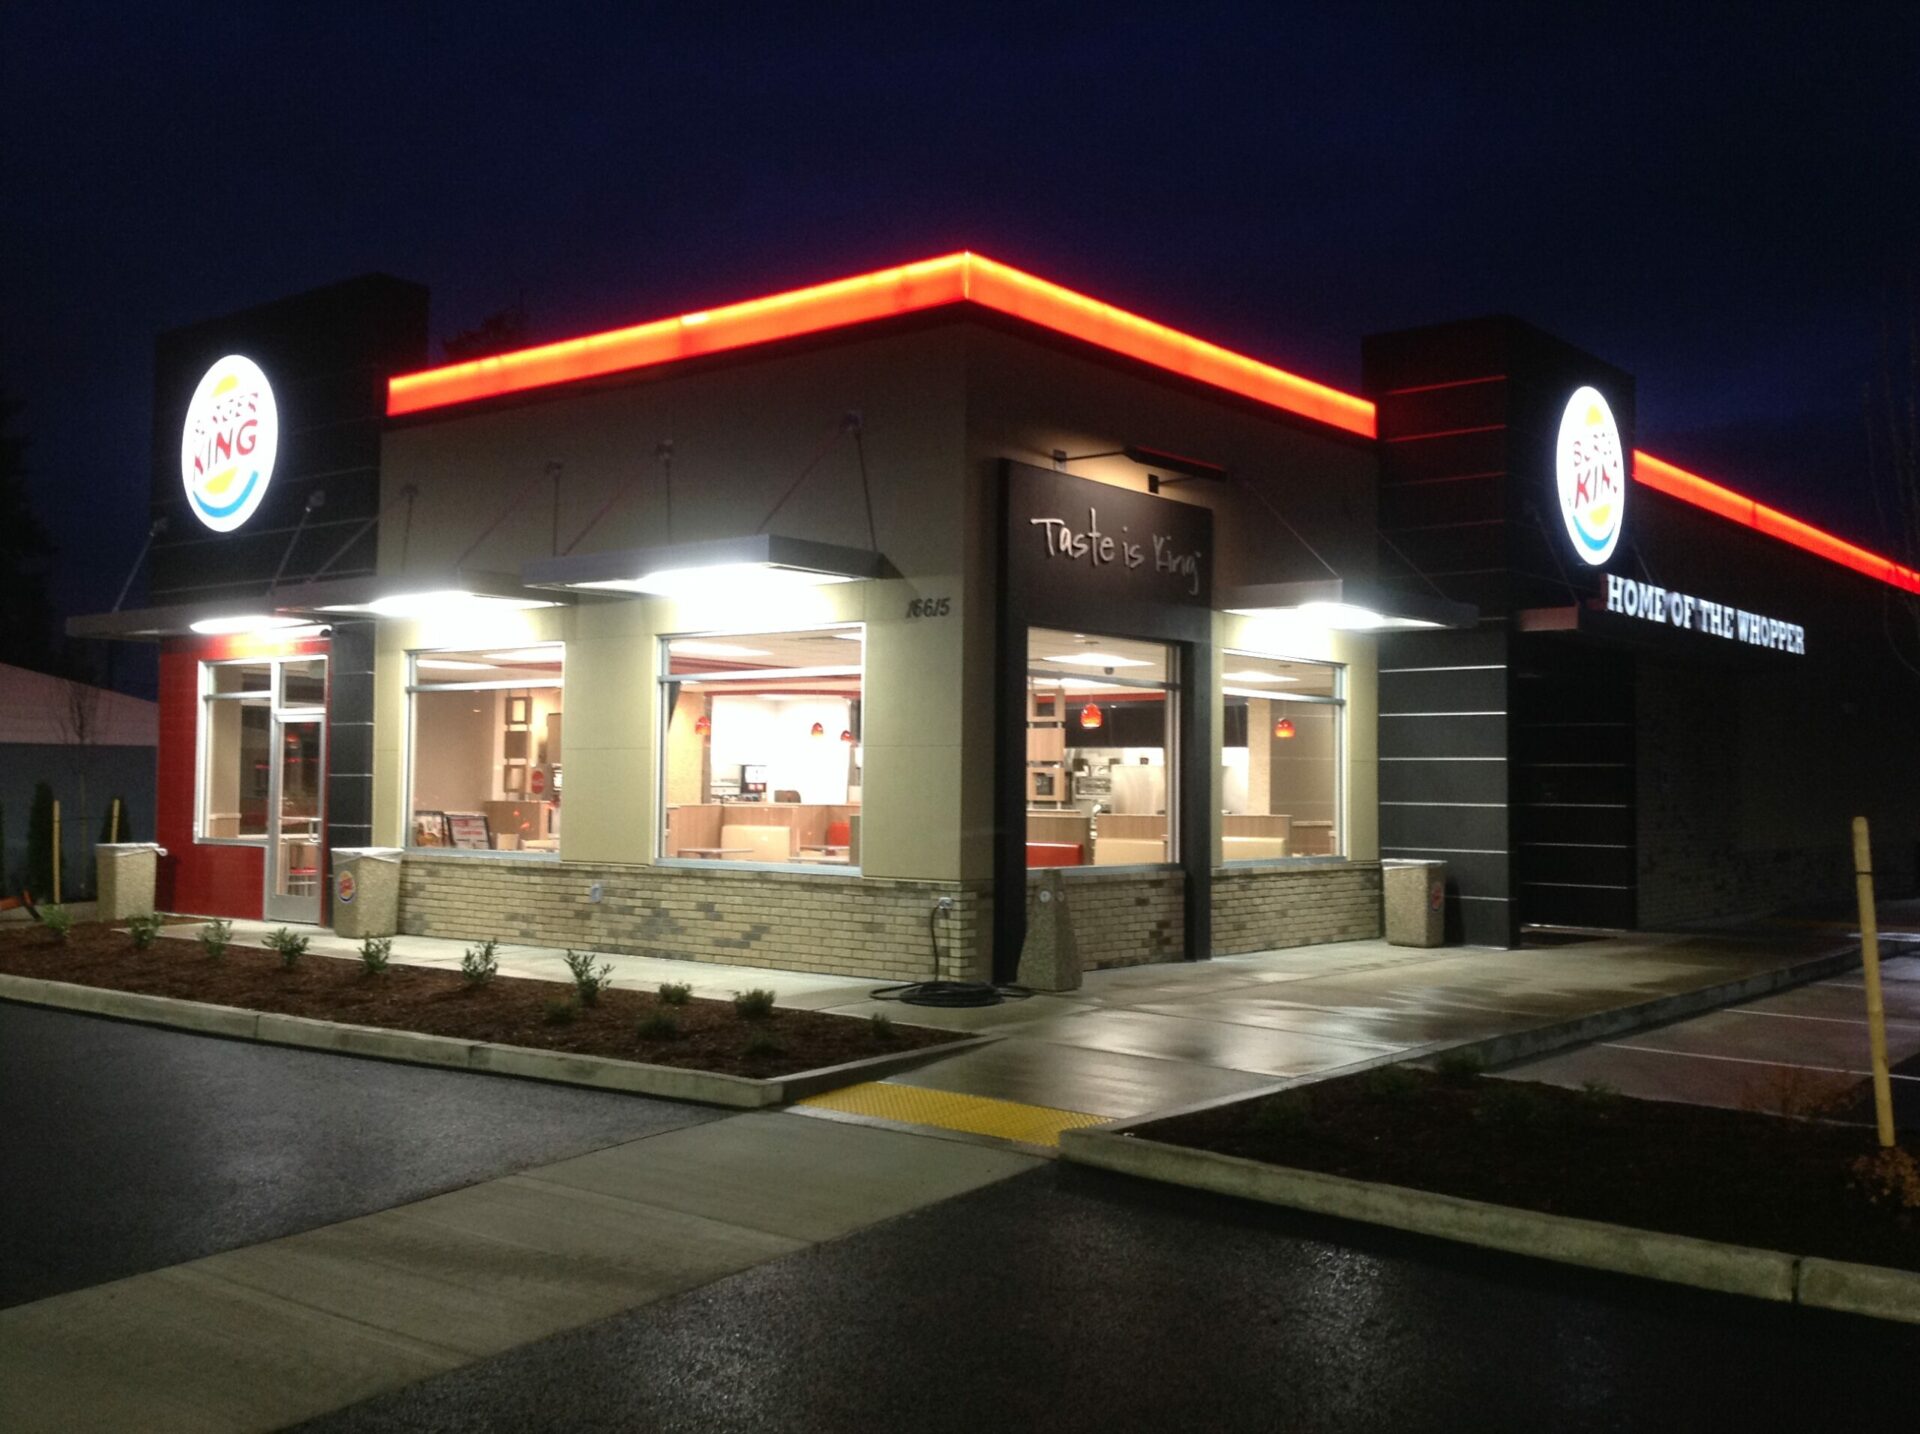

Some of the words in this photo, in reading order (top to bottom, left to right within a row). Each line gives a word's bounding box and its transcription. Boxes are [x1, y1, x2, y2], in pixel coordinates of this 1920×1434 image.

[1573, 461, 1619, 510] KIN
[1030, 507, 1116, 566] Taste
[1122, 526, 1145, 569] is
[1152, 534, 1202, 596] King
[905, 596, 952, 619] 16615
[1607, 573, 1667, 624] HOME
[1670, 591, 1696, 630] OF
[1699, 598, 1735, 640] THE
[1736, 608, 1806, 656] WHOPPER
